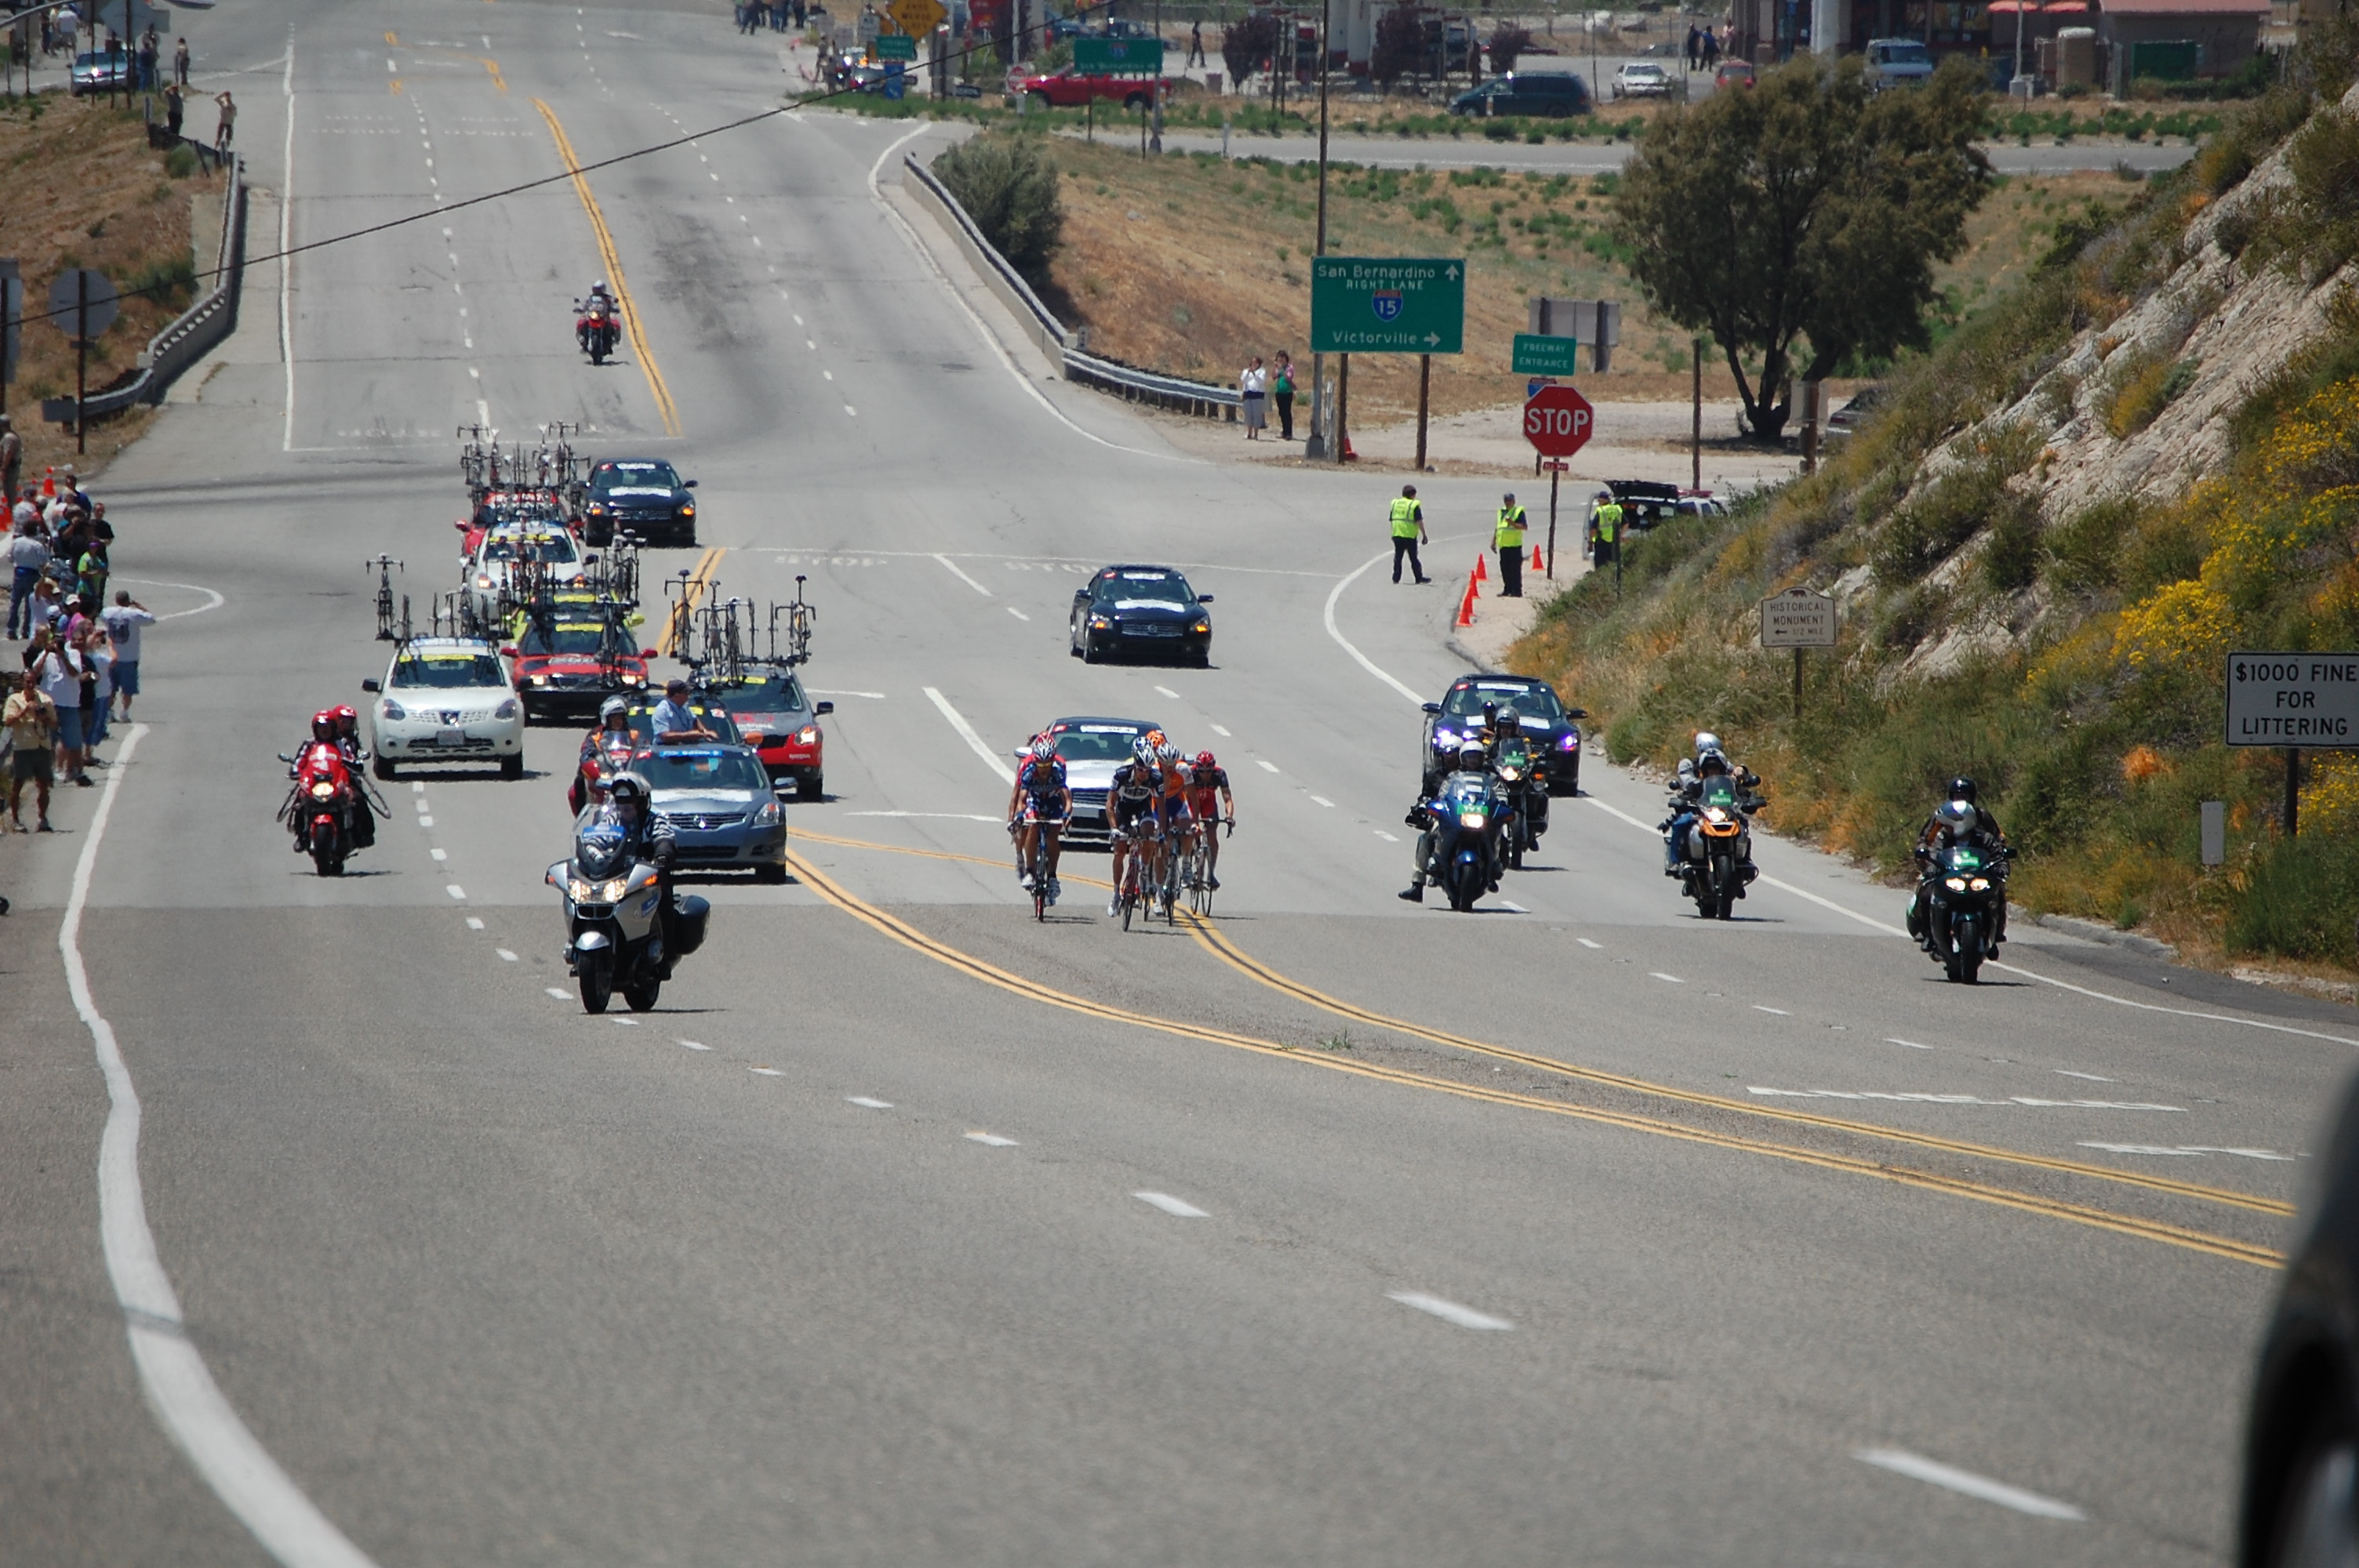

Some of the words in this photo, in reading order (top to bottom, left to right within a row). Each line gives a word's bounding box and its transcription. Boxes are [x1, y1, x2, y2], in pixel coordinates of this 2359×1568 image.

[1318, 264, 1347, 278] San
[1353, 264, 1435, 279] Bernardino
[1346, 279, 1385, 289] RIGHT
[1391, 280, 1424, 291] LANE
[1379, 299, 1397, 315] 15
[1332, 330, 1418, 345] Victorville
[1523, 342, 1567, 354] FREEWAY
[1519, 357, 1568, 369] ENTRANCE
[1527, 408, 1590, 436] STOP
[1770, 601, 1826, 612] HISTORICAL
[1773, 615, 1824, 626] MONUMENT
[2236, 662, 2299, 683] $1000
[2311, 664, 2357, 682] FINE
[2276, 691, 2316, 709] FOR
[2242, 717, 2348, 735] LITTERING
